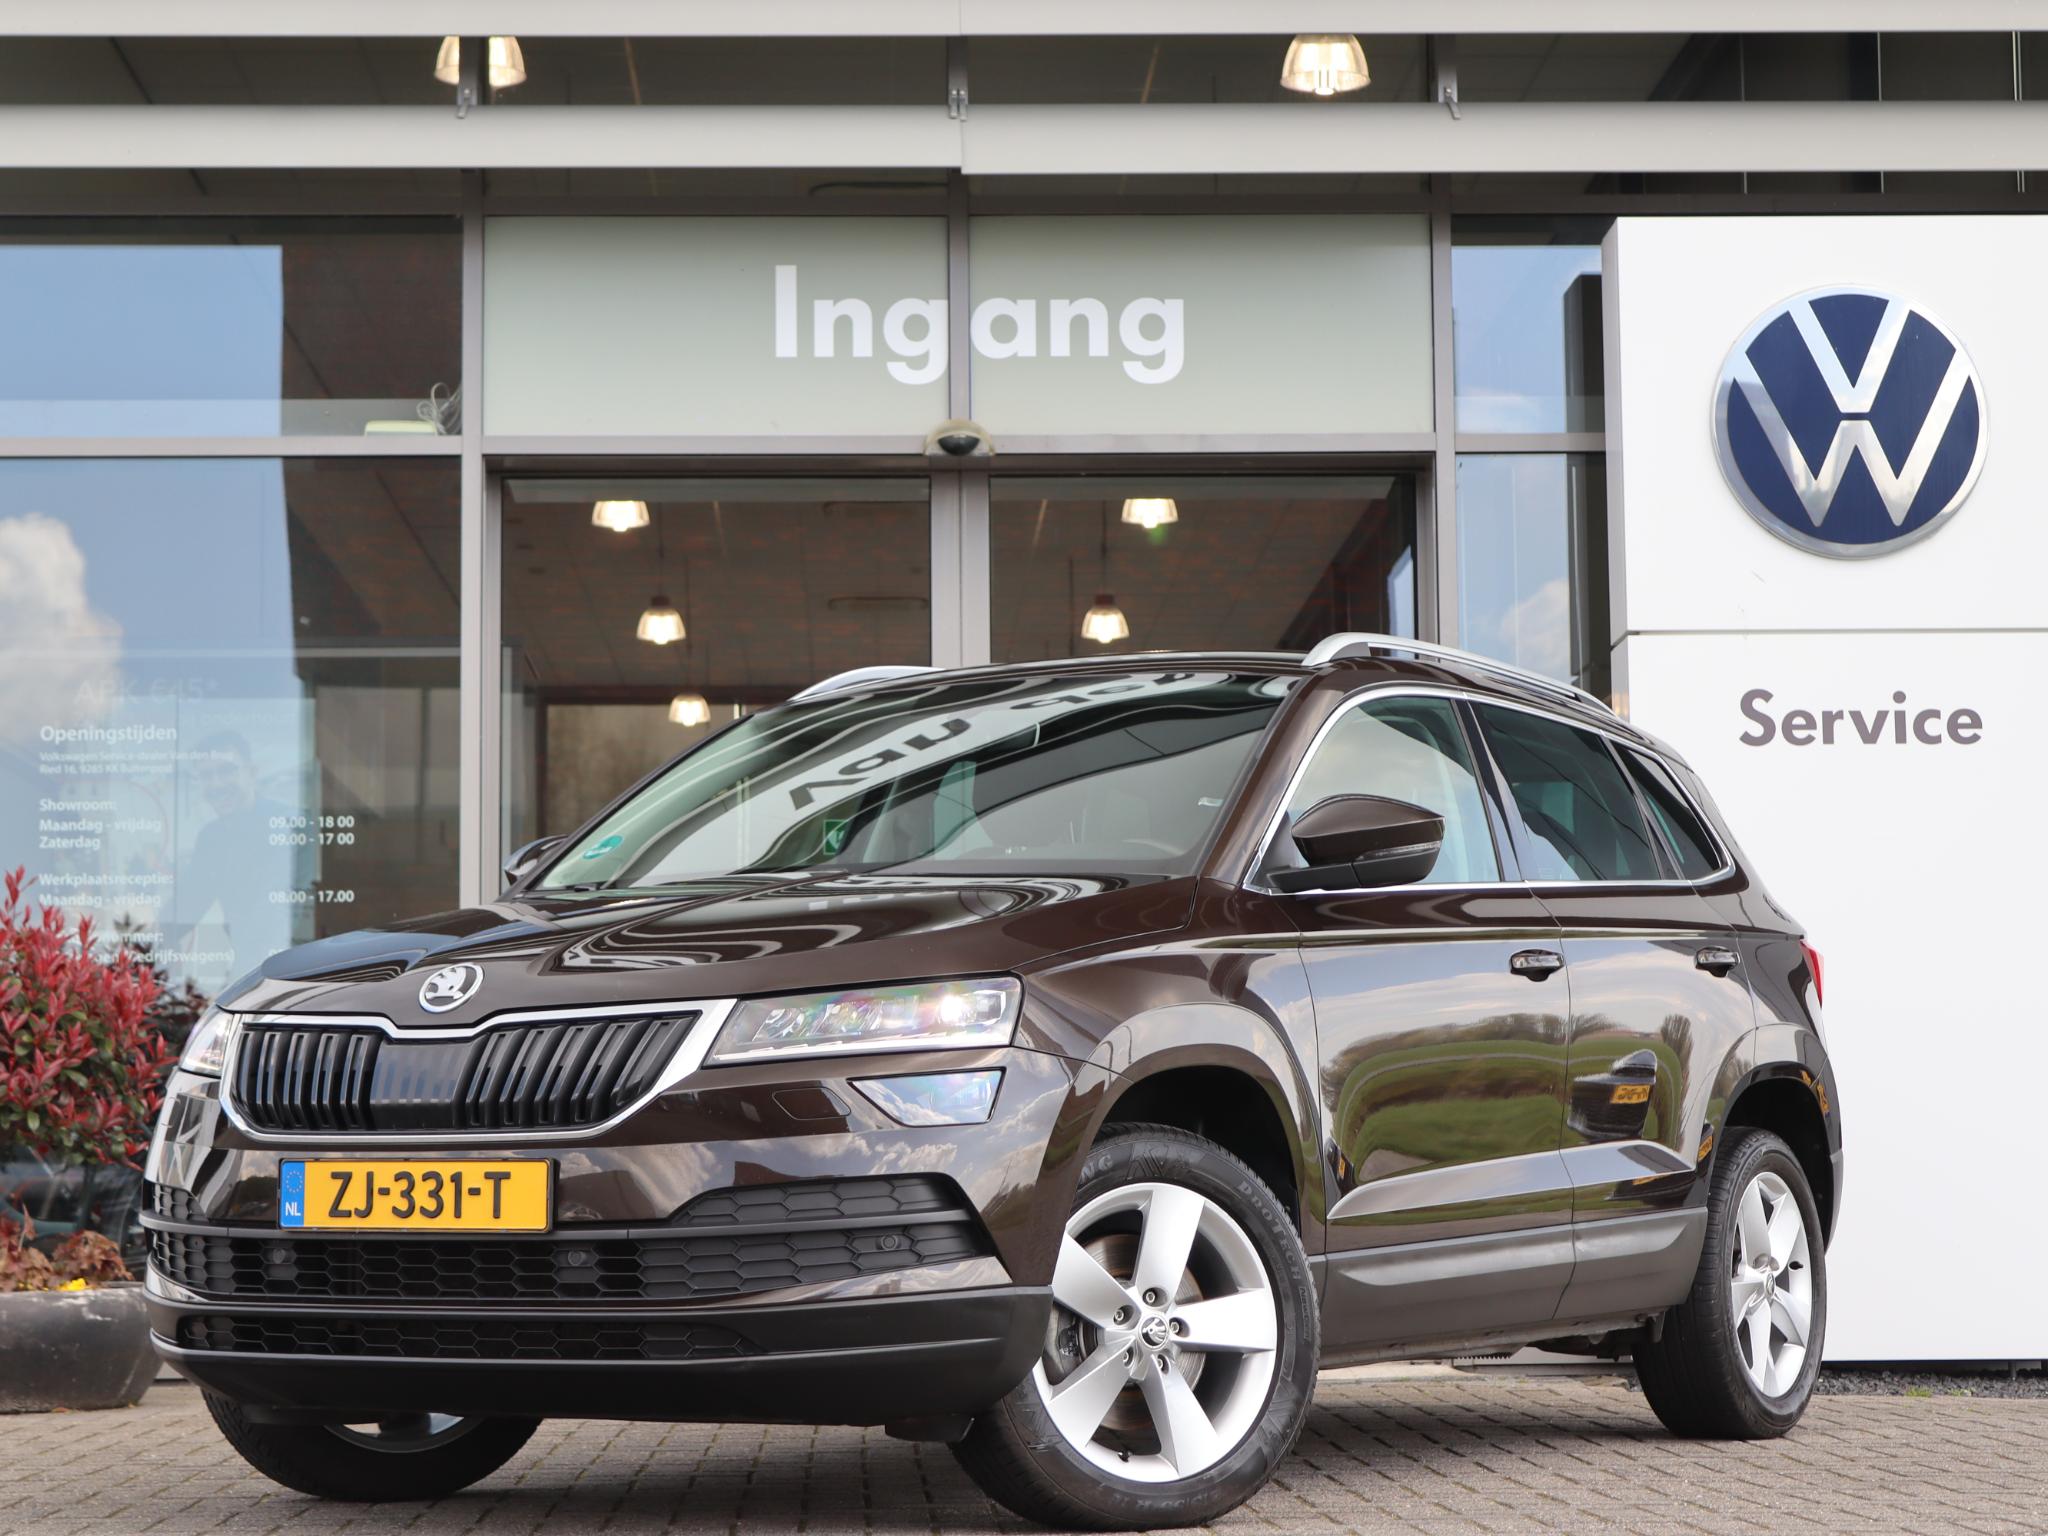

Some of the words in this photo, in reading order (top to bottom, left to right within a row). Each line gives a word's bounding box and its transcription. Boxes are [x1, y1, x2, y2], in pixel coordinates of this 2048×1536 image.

[774, 264, 1186, 385] Ingang
[1738, 687, 1984, 747] Service
[40, 725, 177, 744] Openingstijden
[39, 798, 117, 811] Showroom:
[39, 819, 103, 834] Maandag
[114, 818, 161, 834] vrijdag
[39, 836, 100, 850] Zaterdag
[39, 893, 102, 908] Maandag
[113, 893, 161, 908] vrijdag
[318, 889, 355, 903] 17.00
[328, 1170, 511, 1219] ZJ-331-T
[285, 1202, 301, 1217] NL
